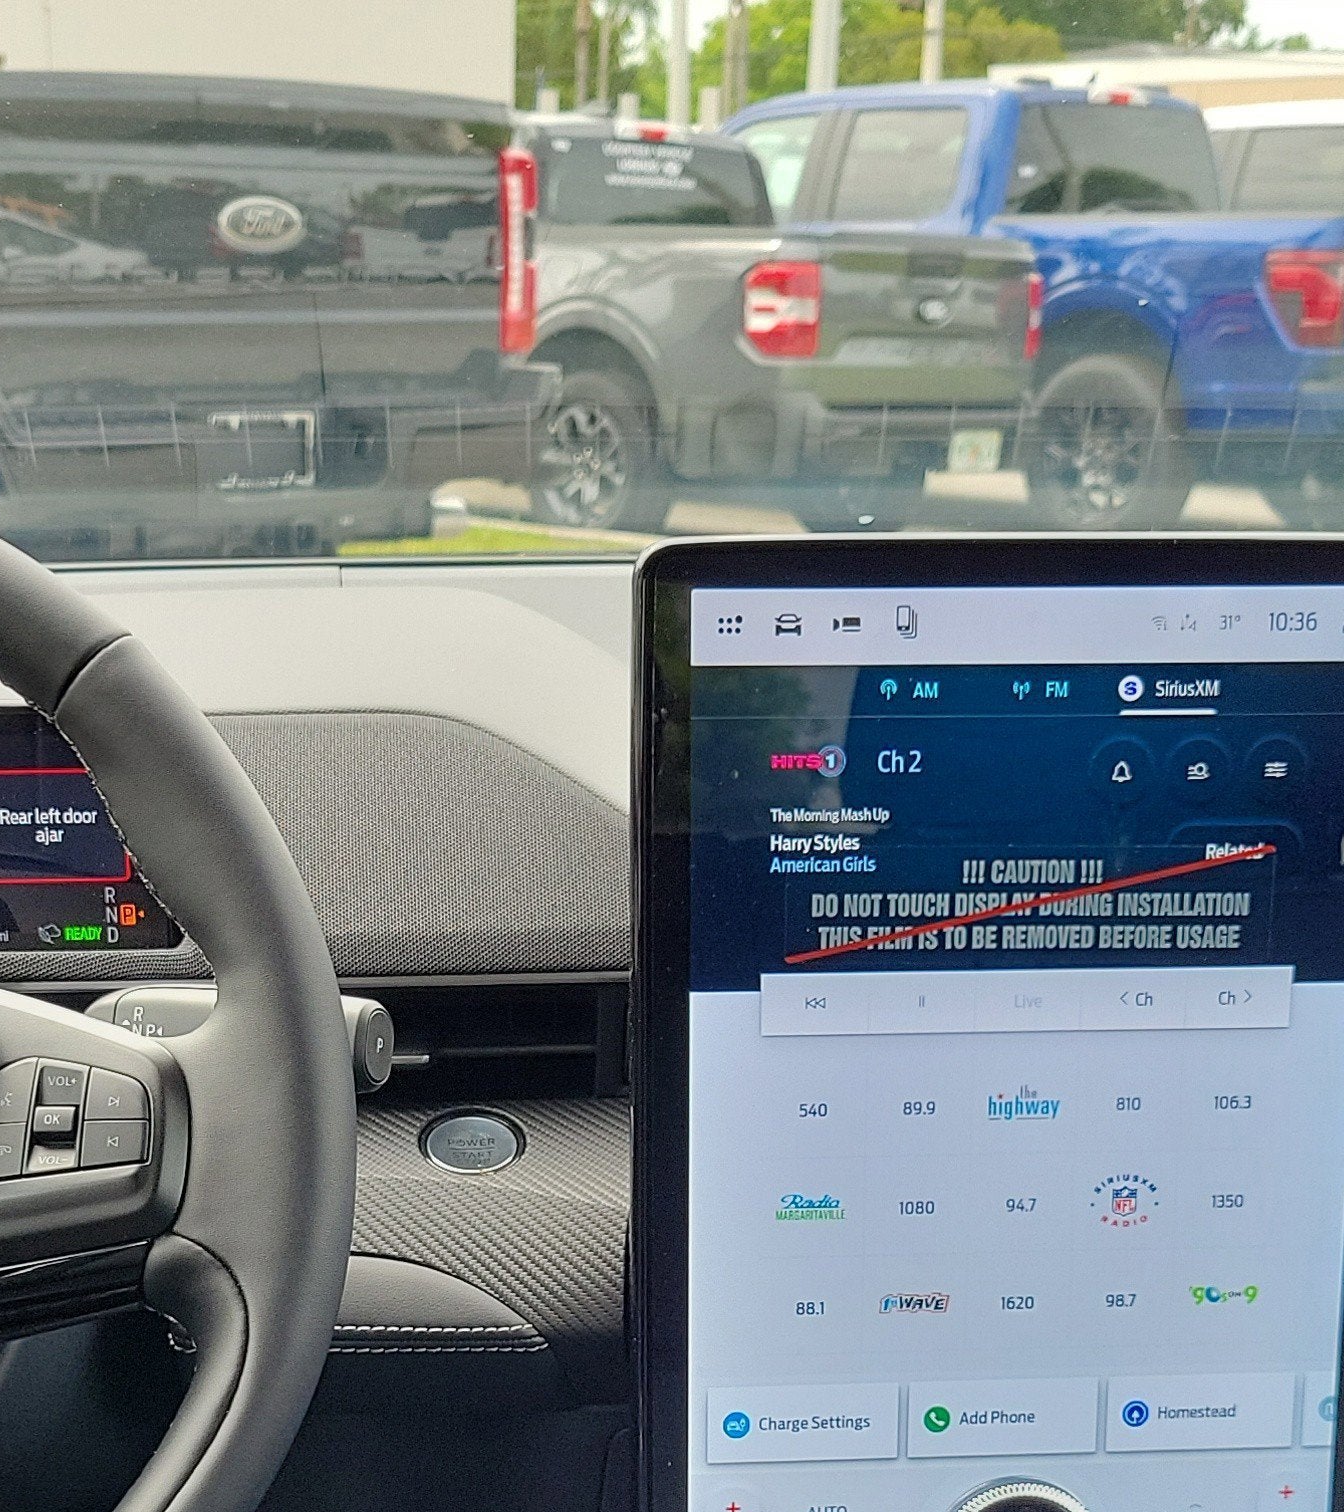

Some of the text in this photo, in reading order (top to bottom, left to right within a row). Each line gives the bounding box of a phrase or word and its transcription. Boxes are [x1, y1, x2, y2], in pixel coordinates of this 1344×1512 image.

[1268, 611, 1319, 633] 10:36
[912, 681, 939, 699] AM
[1045, 681, 1069, 698] FM
[1155, 679, 1220, 698] SiriusXM
[877, 750, 923, 773] Ch 2
[34, 808, 63, 825] left
[63, 808, 98, 825] door
[769, 807, 891, 825] The Morning Mash Up
[35, 827, 65, 846] ajar
[769, 833, 861, 854] Harry Styles
[769, 855, 877, 874] American Girls
[991, 859, 1076, 884] CAUTION
[104, 886, 116, 904] R
[811, 891, 1251, 918] DO NOT TOUCH DISPLAY DURING INSTALLATION
[106, 907, 133, 923] N P
[64, 927, 103, 942] READY
[107, 927, 120, 943] D
[817, 924, 1242, 951] THIS FILM IS TO BE REMOVED BEFORE USAGE
[1014, 994, 1043, 1009] Live
[1135, 992, 1154, 1007] Ch
[1218, 990, 1236, 1006] Ch
[133, 1006, 145, 1022] R
[132, 1023, 156, 1037] N P
[376, 1037, 385, 1053] P
[1019, 1084, 1038, 1099] the
[798, 1103, 828, 1118] 540
[902, 1101, 936, 1116] 89.9
[988, 1095, 1061, 1120] highway
[1115, 1097, 1142, 1112] 810
[1214, 1095, 1252, 1110] 106.3
[44, 1114, 60, 1125] OK
[447, 1137, 495, 1147] POWER
[780, 1194, 841, 1209] Radio
[898, 1200, 936, 1216] 1080
[1005, 1198, 1037, 1213] 94.7
[1115, 1199, 1136, 1213] NFL
[1211, 1194, 1245, 1209] 1350
[774, 1208, 847, 1221] MARGARITAVILLE
[1100, 1214, 1148, 1228] RADIO
[1000, 1295, 1036, 1310] 1620
[1105, 1293, 1137, 1308] 98.7
[1243, 1285, 1259, 1304] 9
[795, 1301, 826, 1316] 88.1
[898, 1295, 946, 1312] WAVE
[959, 1409, 1036, 1426] Add Phone
[1157, 1404, 1237, 1419] Homestead
[758, 1414, 871, 1433] Charge Settings
